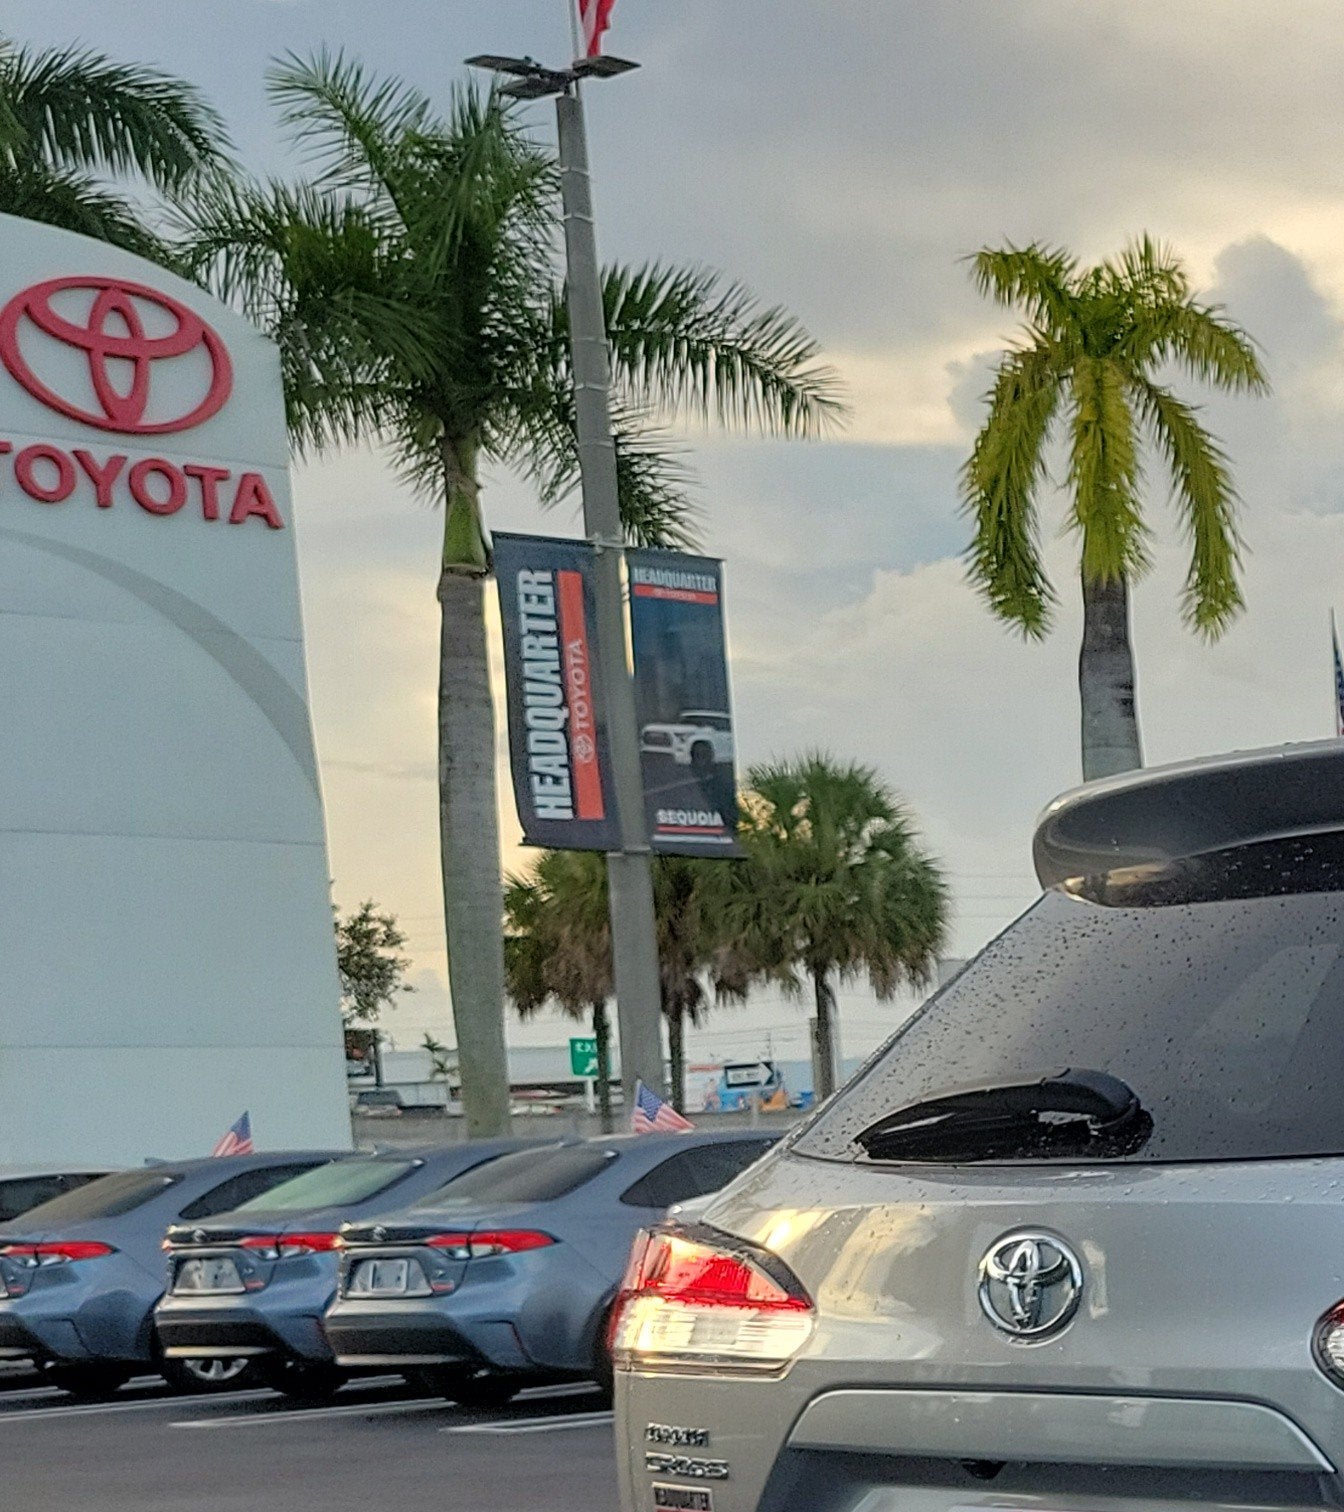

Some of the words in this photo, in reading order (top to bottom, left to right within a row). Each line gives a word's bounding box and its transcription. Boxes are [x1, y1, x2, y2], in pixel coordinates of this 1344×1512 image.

[517, 569, 574, 820] HEADQUARTER
[566, 639, 592, 730] TOYOTA
[656, 809, 725, 826] SEQUOIA
